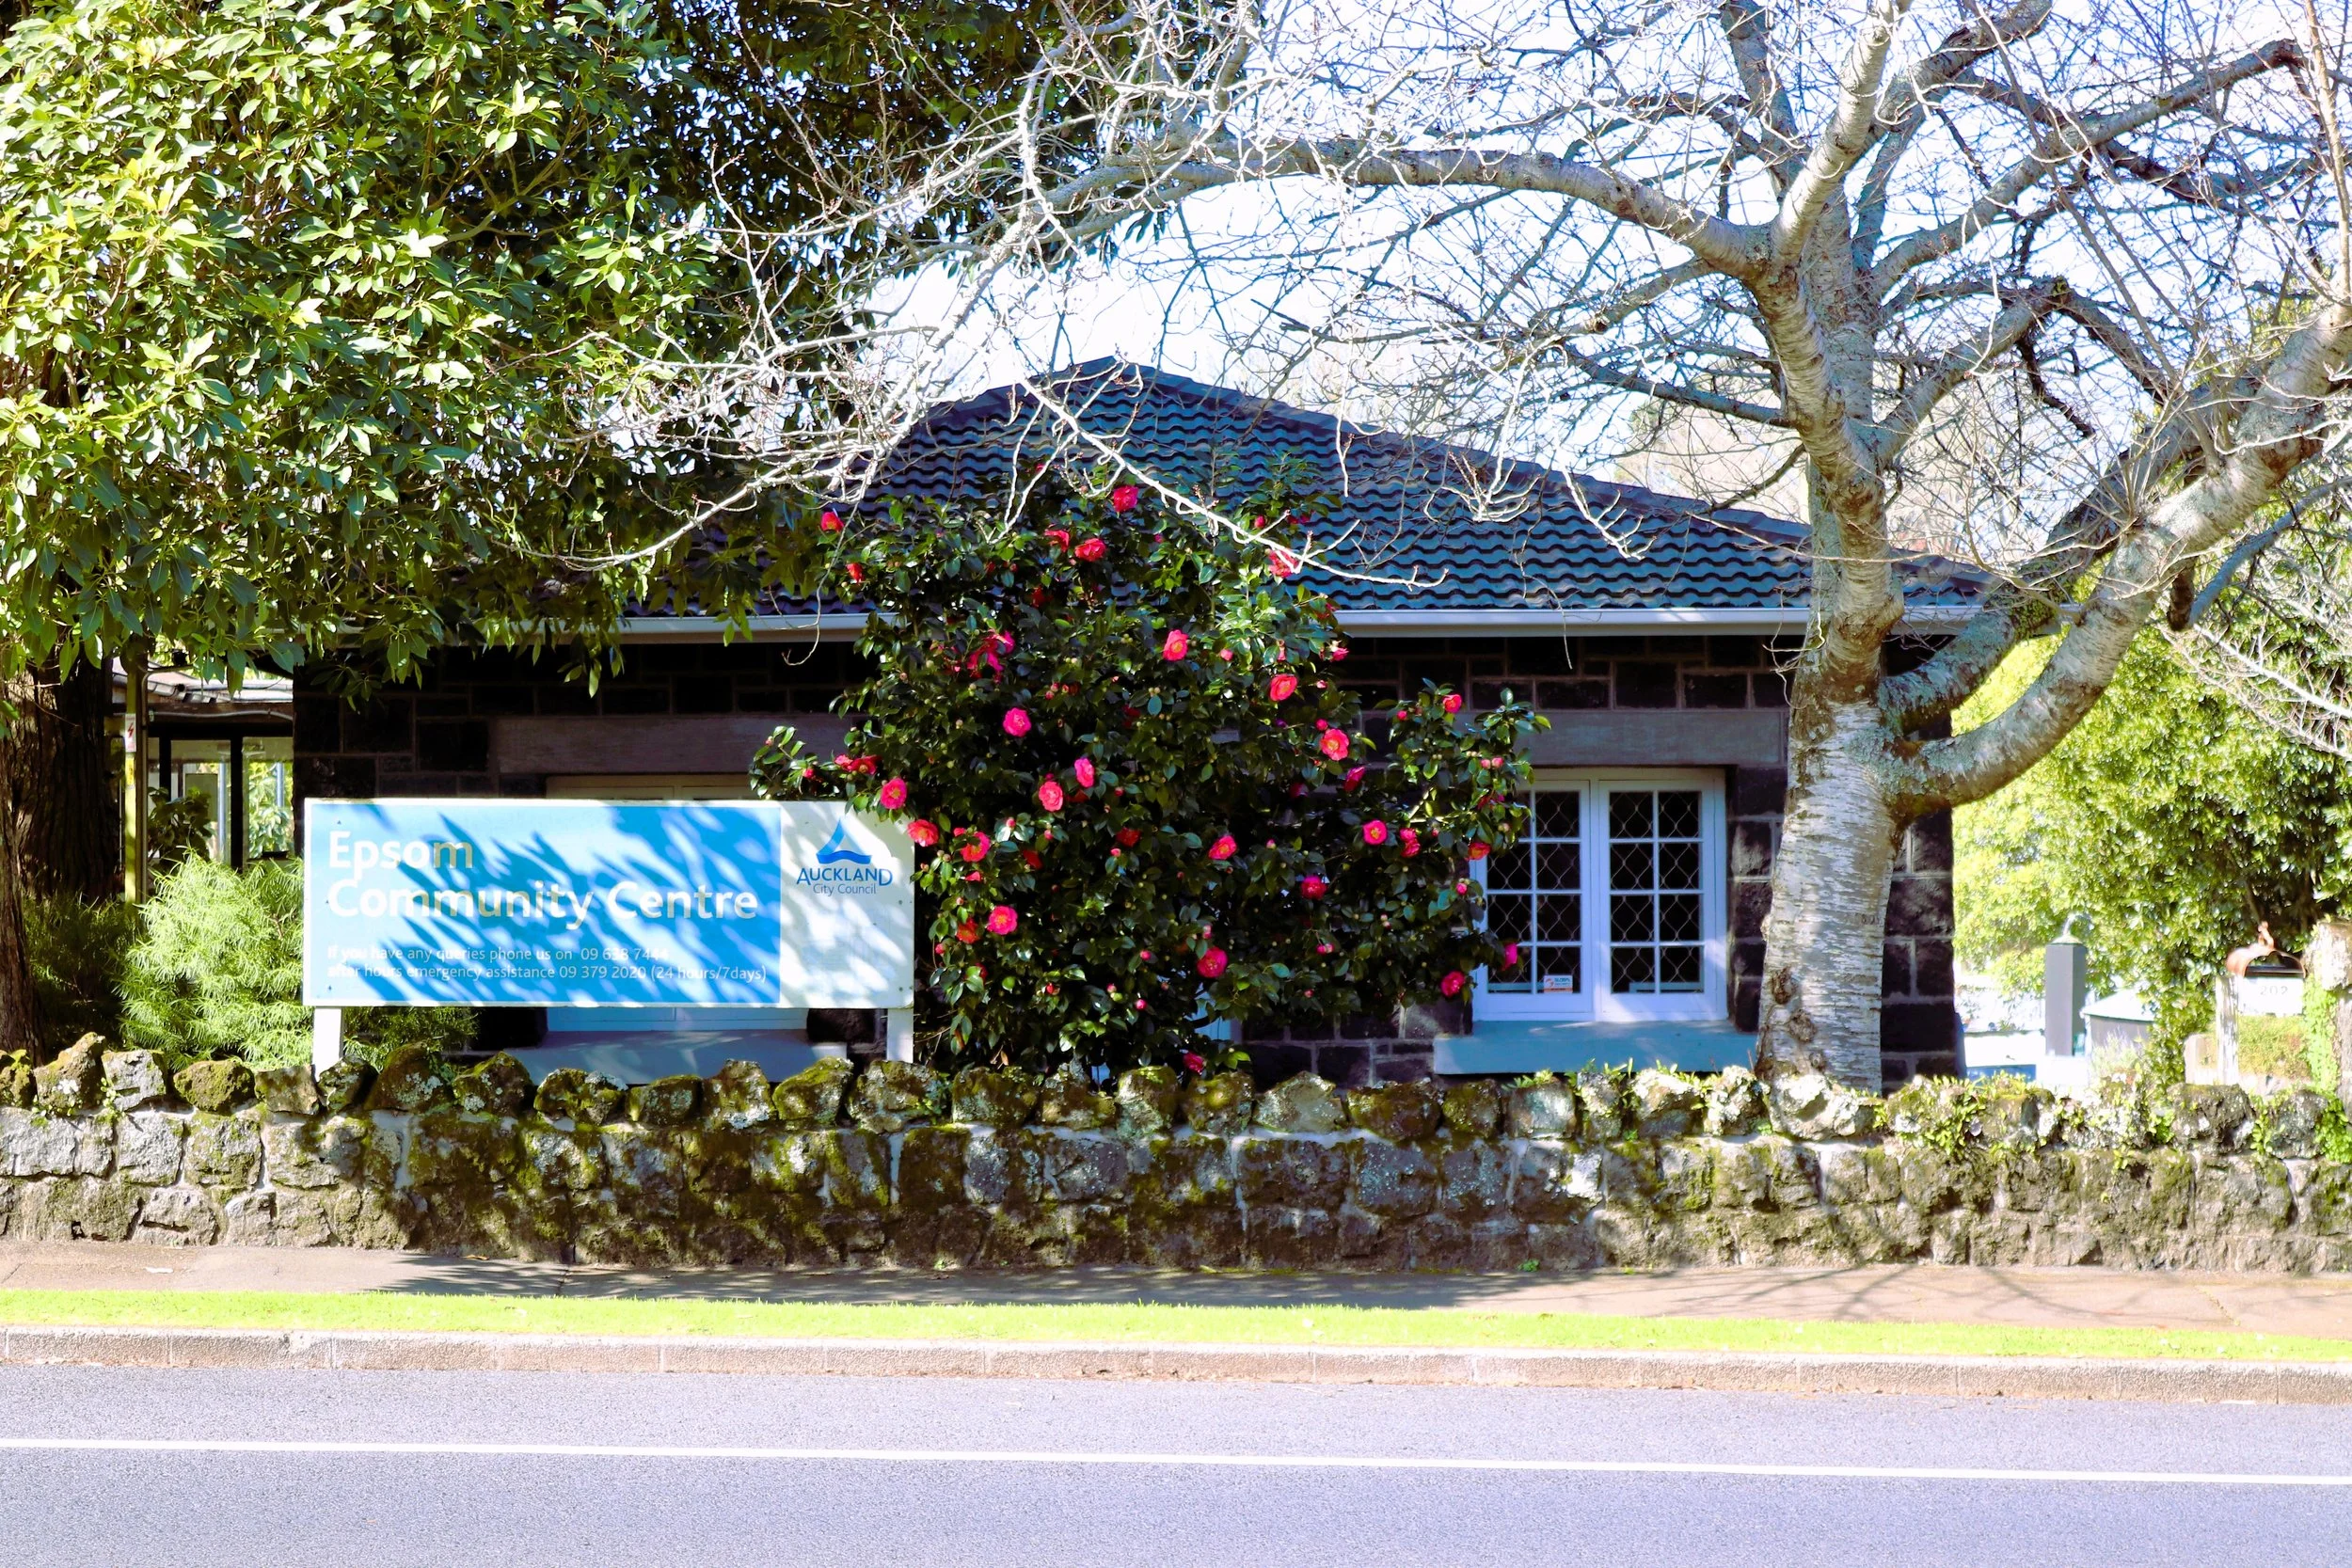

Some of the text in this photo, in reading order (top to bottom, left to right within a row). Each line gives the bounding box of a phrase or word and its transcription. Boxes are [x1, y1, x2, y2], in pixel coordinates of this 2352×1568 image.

[329, 831, 473, 880] Epsom
[796, 867, 893, 886] AUCKLAND
[813, 883, 877, 896] City Council
[328, 879, 758, 930] Community Centre
[371, 946, 403, 960] have
[407, 949, 433, 963] any
[437, 947, 485, 963] queries
[489, 946, 532, 963] phone
[535, 949, 550, 960] us
[556, 950, 572, 960] on
[580, 947, 599, 960] 09
[602, 947, 629, 961] 638
[364, 964, 403, 977] hours
[406, 966, 482, 981] emergency
[485, 965, 555, 978] assistance
[559, 966, 577, 978] 09
[580, 966, 607, 979] 379
[612, 966, 646, 979] 2020
[651, 965, 674, 981] (24
[677, 965, 767, 983] hours/7days)
